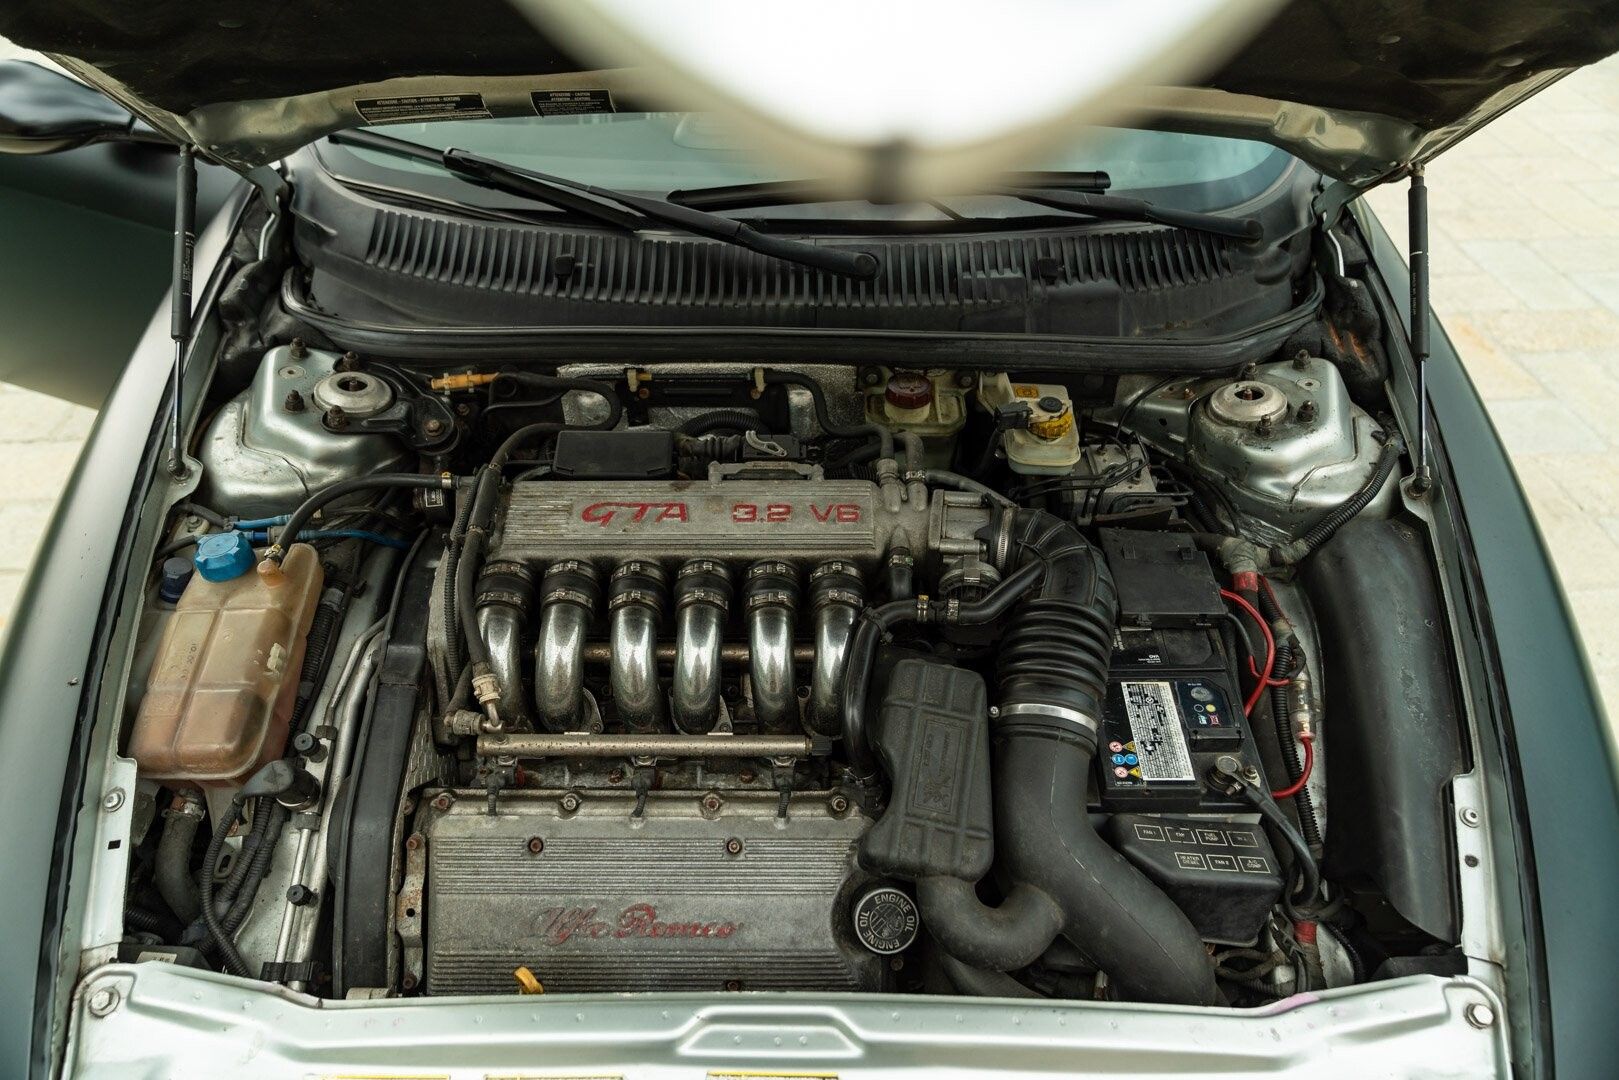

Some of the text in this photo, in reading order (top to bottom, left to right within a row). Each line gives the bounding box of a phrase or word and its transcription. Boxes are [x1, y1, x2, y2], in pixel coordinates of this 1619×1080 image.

[581, 501, 861, 527] GTA 3.2 V6
[612, 902, 744, 939] Romeo
[859, 910, 900, 949] ENGINE OIL
[874, 893, 915, 932] ENGINE OIL
